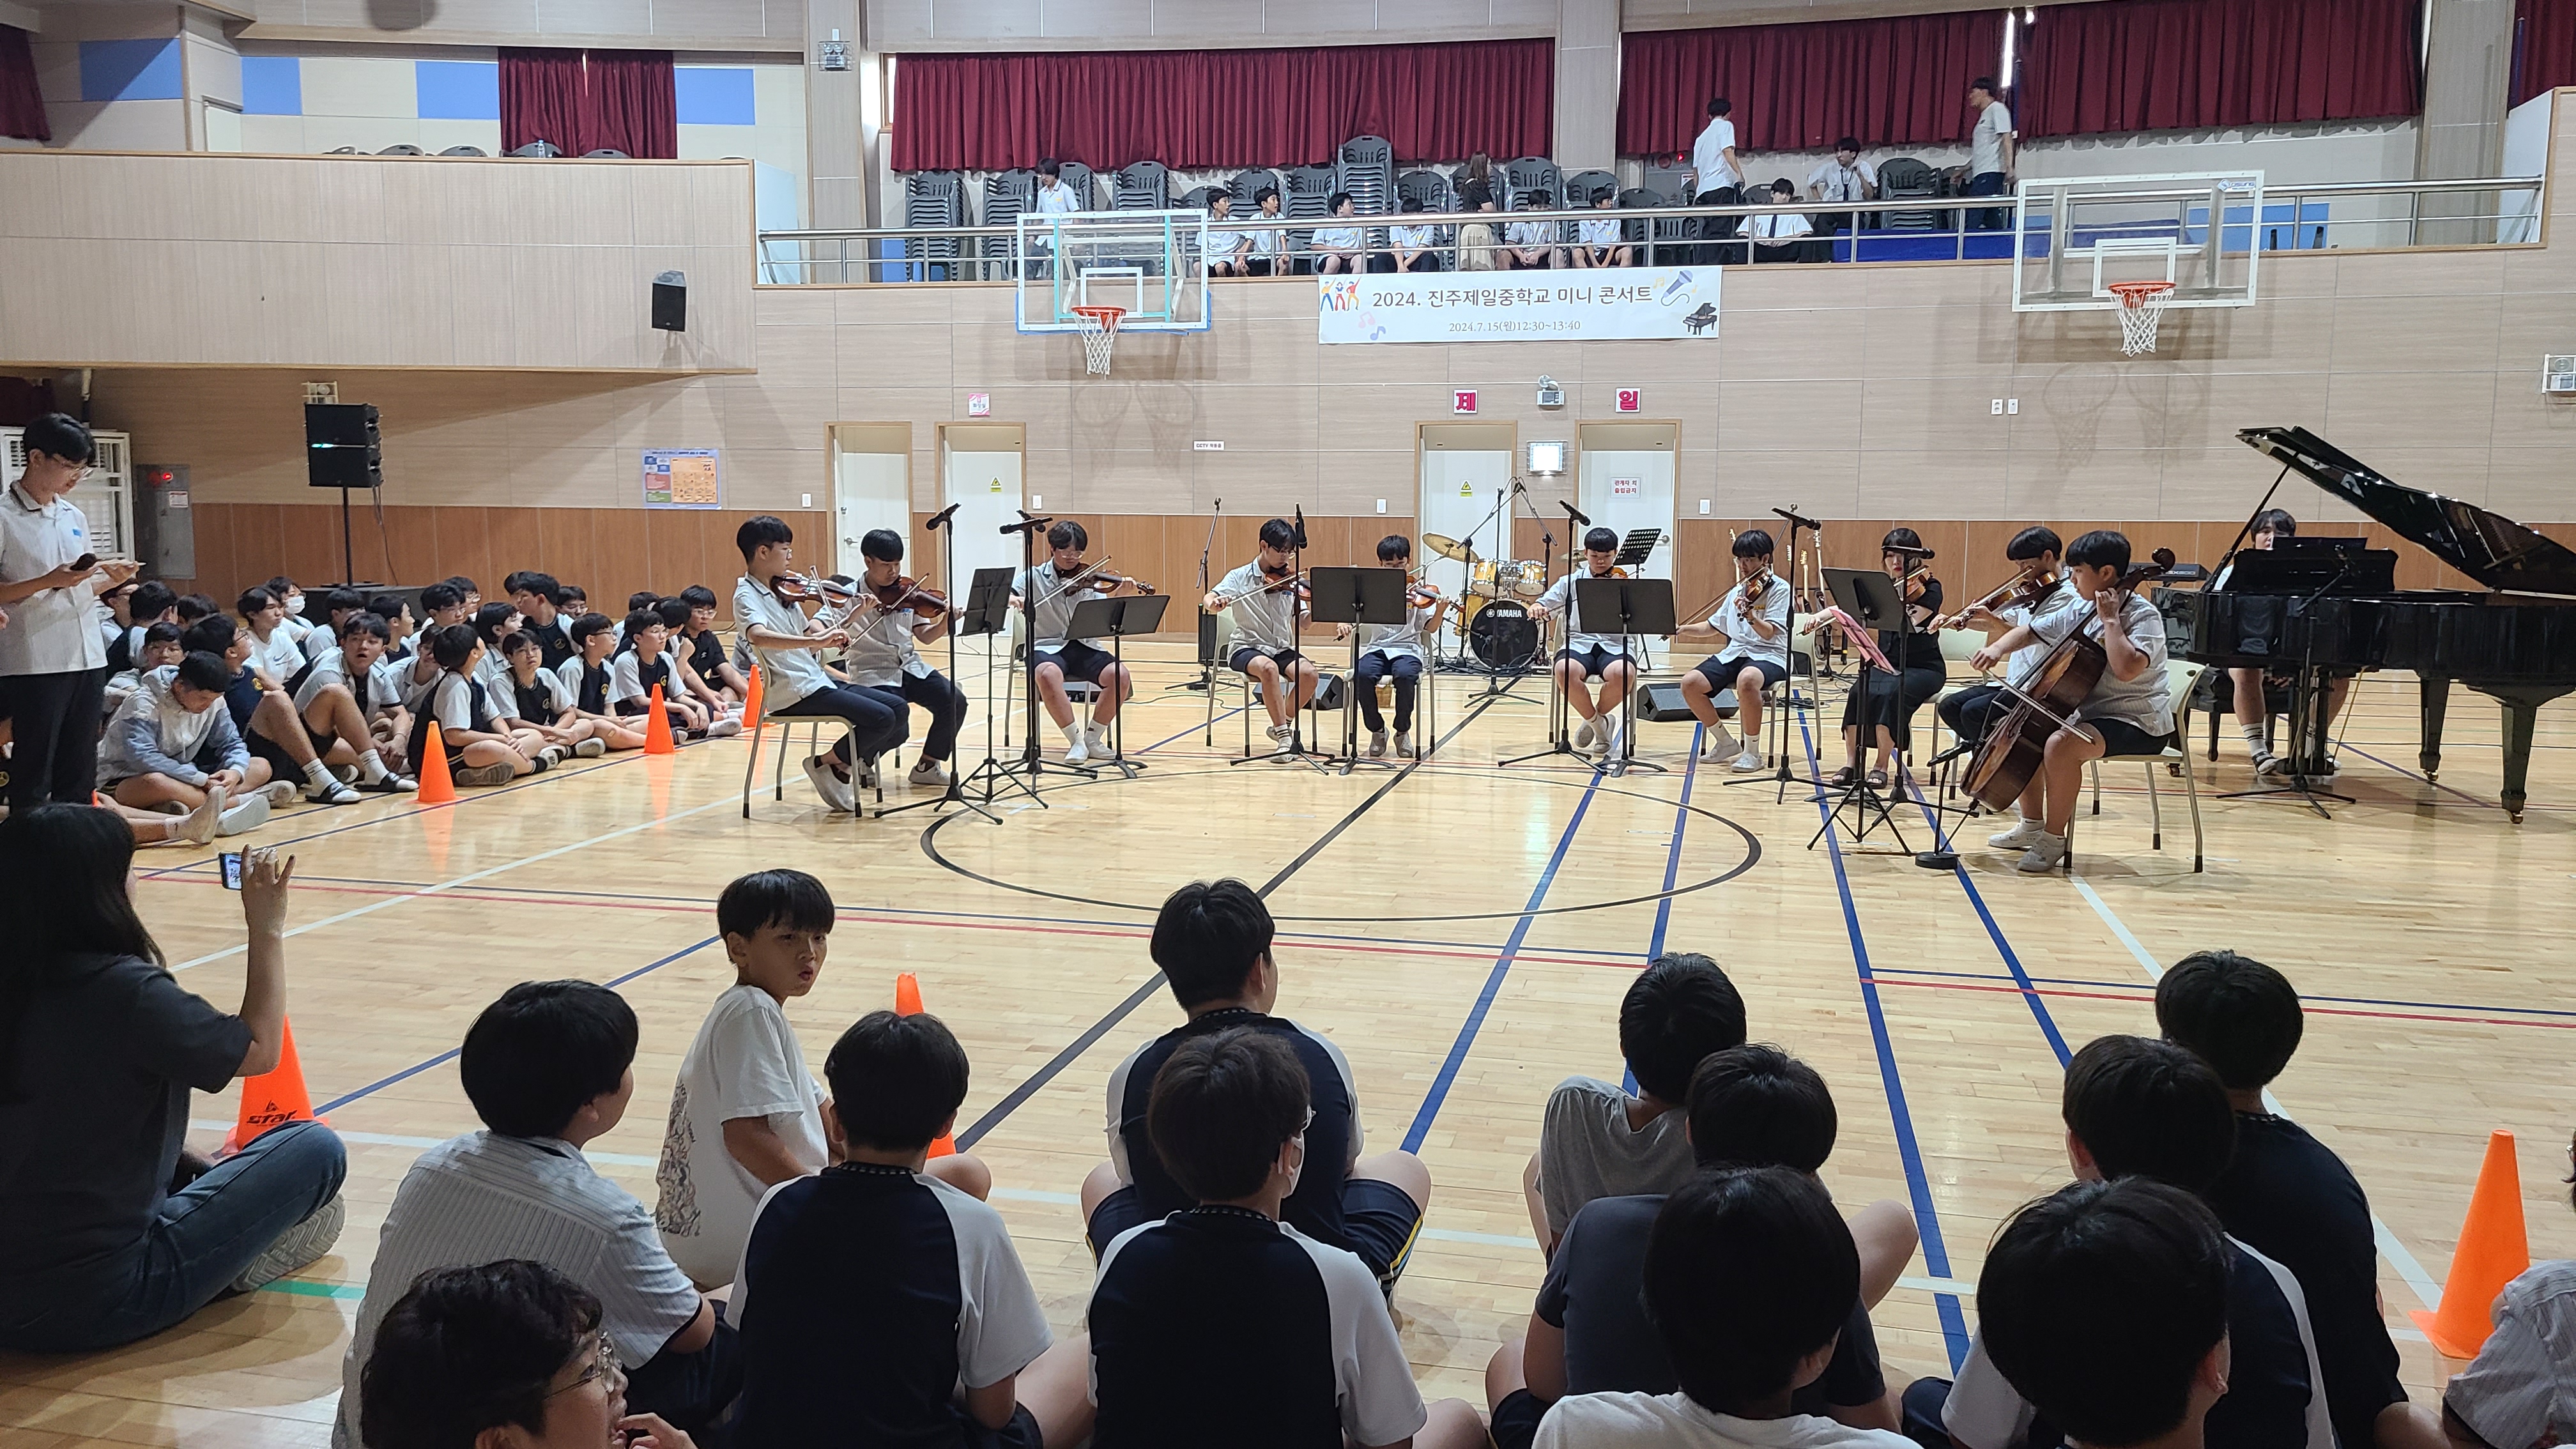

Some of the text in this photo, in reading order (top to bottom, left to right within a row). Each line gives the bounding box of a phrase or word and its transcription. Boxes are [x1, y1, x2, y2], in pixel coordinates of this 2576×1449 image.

[1373, 286, 1653, 308] 2024. 진주제일중학교 미니 콘서트
[1455, 392, 1476, 411] 제
[1618, 390, 1639, 410] 일
[1496, 609, 1522, 618] YAMAHA
